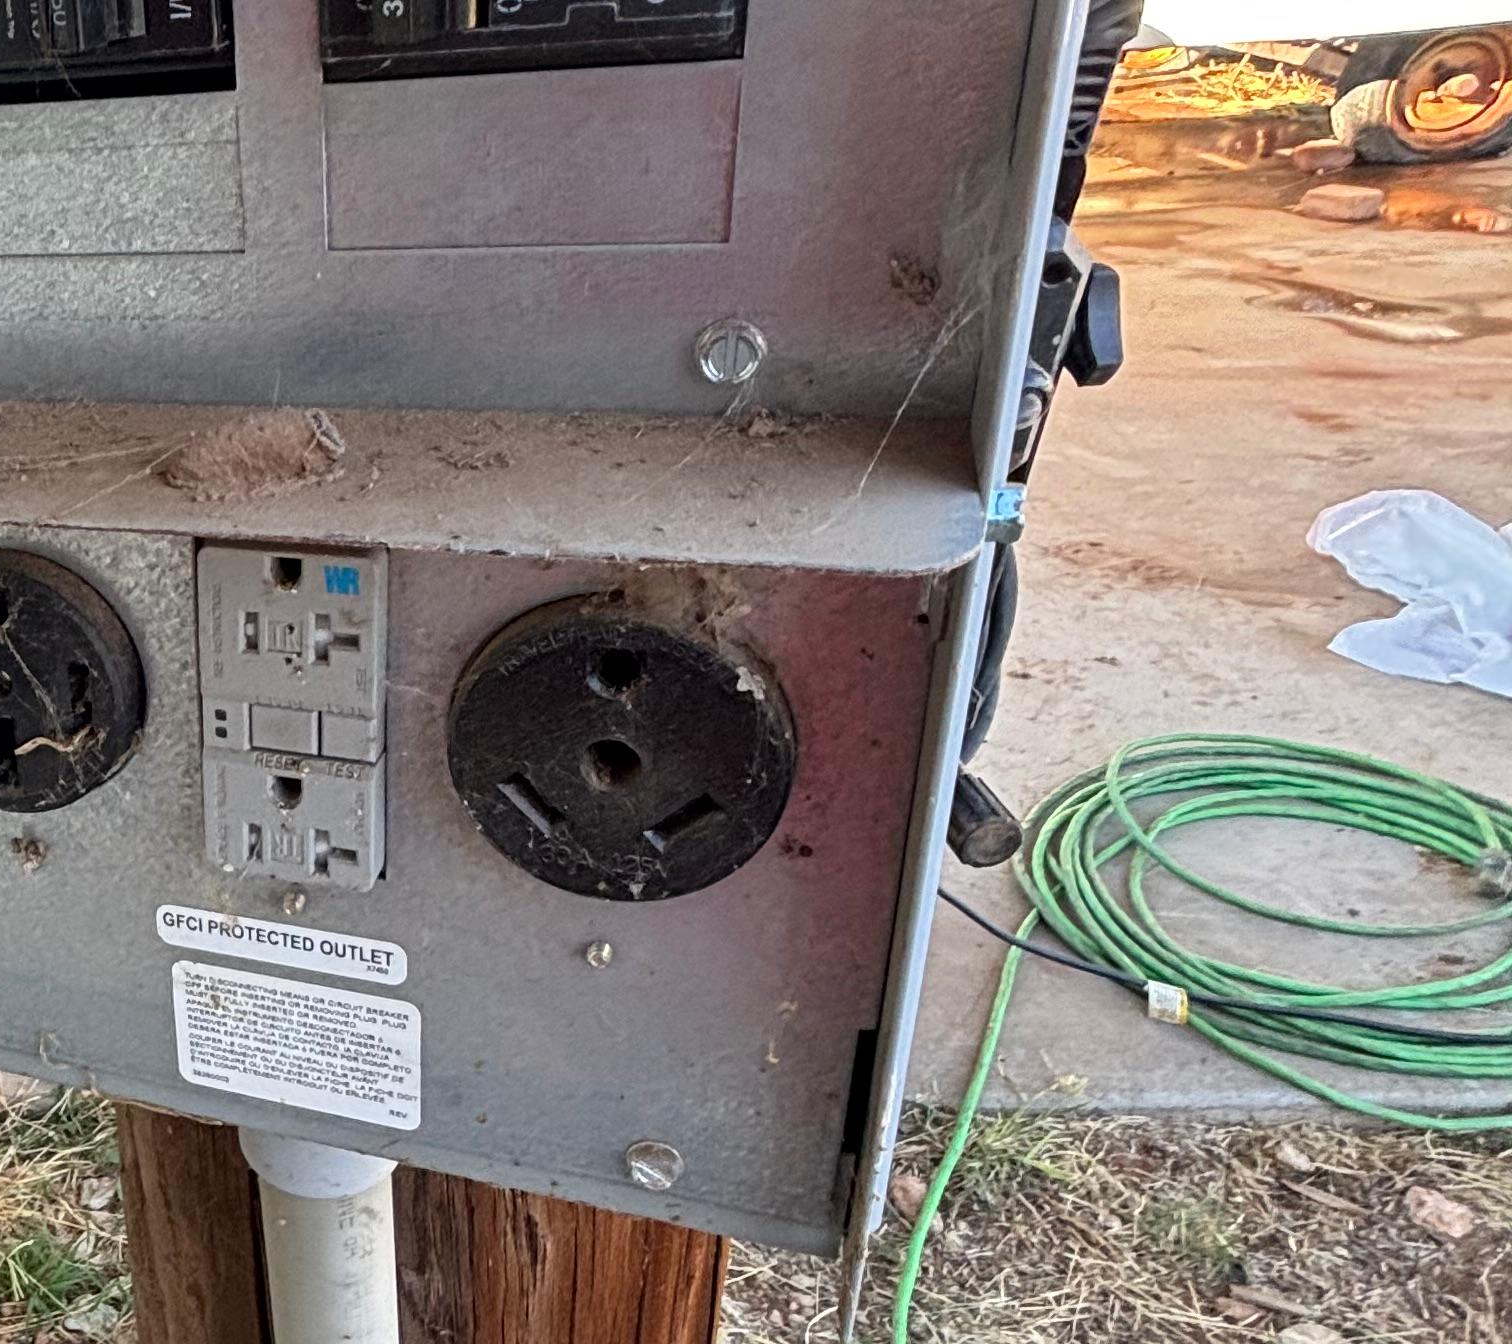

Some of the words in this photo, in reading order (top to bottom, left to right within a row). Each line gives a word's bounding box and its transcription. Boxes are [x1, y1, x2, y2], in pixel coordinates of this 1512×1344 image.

[323, 564, 361, 596] WR
[326, 760, 364, 781] TEST
[162, 912, 204, 932] GFCI
[208, 919, 315, 952] PROTECTED
[319, 939, 395, 968] OUTLET
